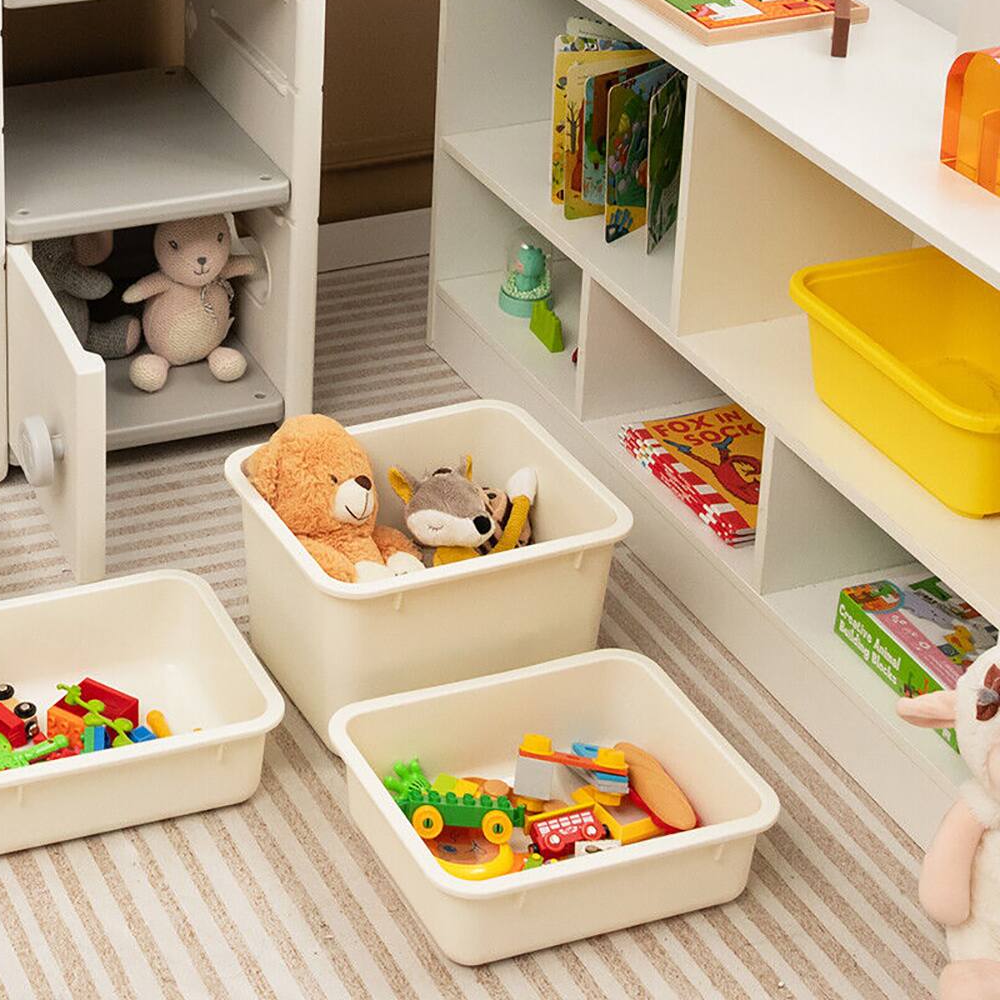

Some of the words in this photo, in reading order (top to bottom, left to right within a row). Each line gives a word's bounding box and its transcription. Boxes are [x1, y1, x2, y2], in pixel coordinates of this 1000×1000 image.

[652, 415, 713, 437] FOX
[715, 410, 742, 424] IN
[839, 603, 873, 643] Creative
[873, 638, 902, 671] Animal
[839, 620, 869, 661] Building
[871, 653, 897, 684] Blocks
